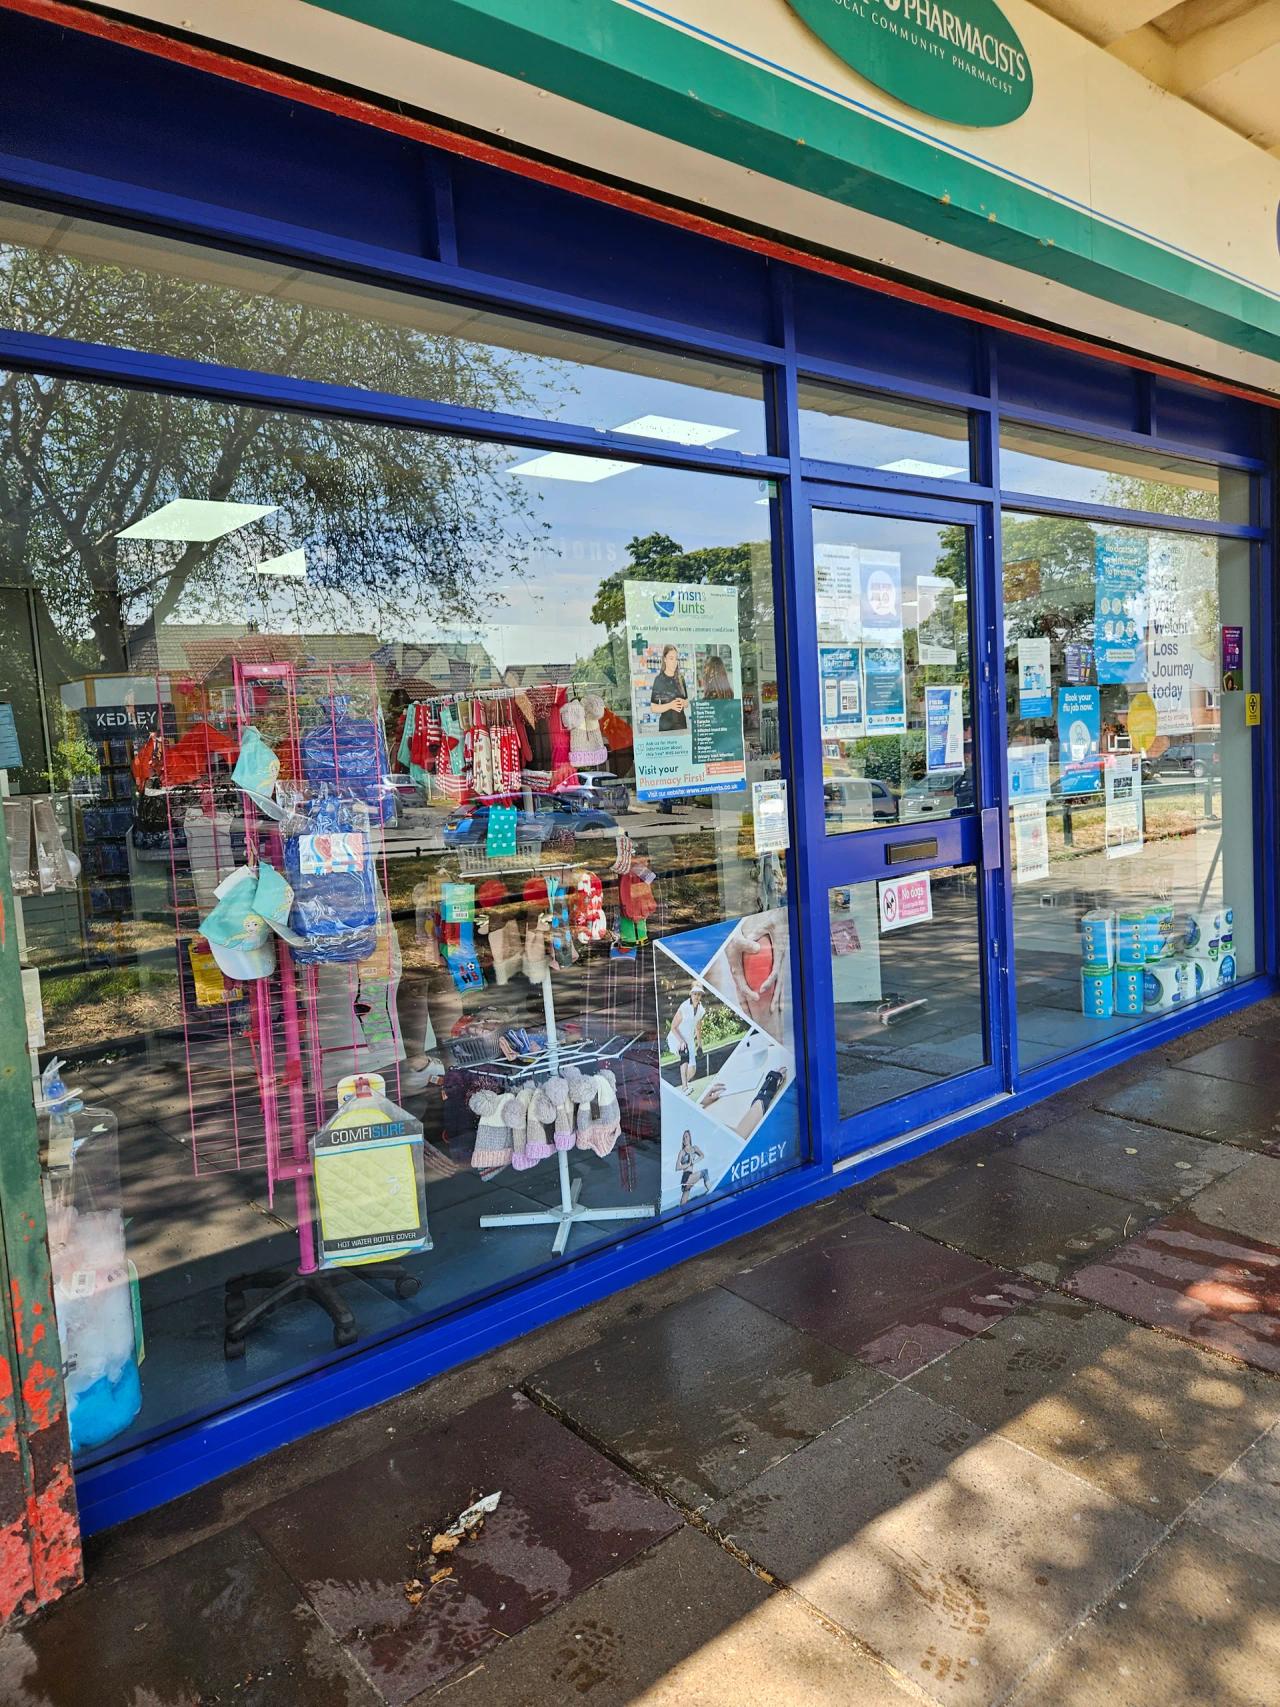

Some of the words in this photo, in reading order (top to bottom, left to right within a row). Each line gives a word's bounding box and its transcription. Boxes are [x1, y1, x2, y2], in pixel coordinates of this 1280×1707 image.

[903, 0, 1026, 82] PHARMACISTS
[871, 12, 945, 60] COMMUNITY
[952, 55, 1013, 95] PHARMACIST
[678, 601, 705, 614] lunts
[1153, 618, 1189, 638] Weight
[1153, 640, 1178, 656] Loss
[1152, 661, 1194, 680] Journey
[1065, 693, 1077, 702] Book
[1078, 694, 1092, 703] your
[1152, 682, 1183, 701] today
[1070, 703, 1079, 714] jab
[96, 711, 157, 727] KEDLEY
[639, 765, 656, 775] Visit
[658, 765, 679, 776] your
[639, 777, 680, 788] Pharmacy
[684, 772, 705, 783] First!
[902, 888, 910, 900] No
[911, 886, 924, 900] dogs
[331, 1122, 405, 1144] COMFISURE
[731, 1140, 787, 1182] KEDLEY
[337, 1240, 351, 1249] HOT
[351, 1238, 373, 1248] WATER
[373, 1235, 396, 1246] BOTTLE
[396, 1232, 417, 1243] COVER
